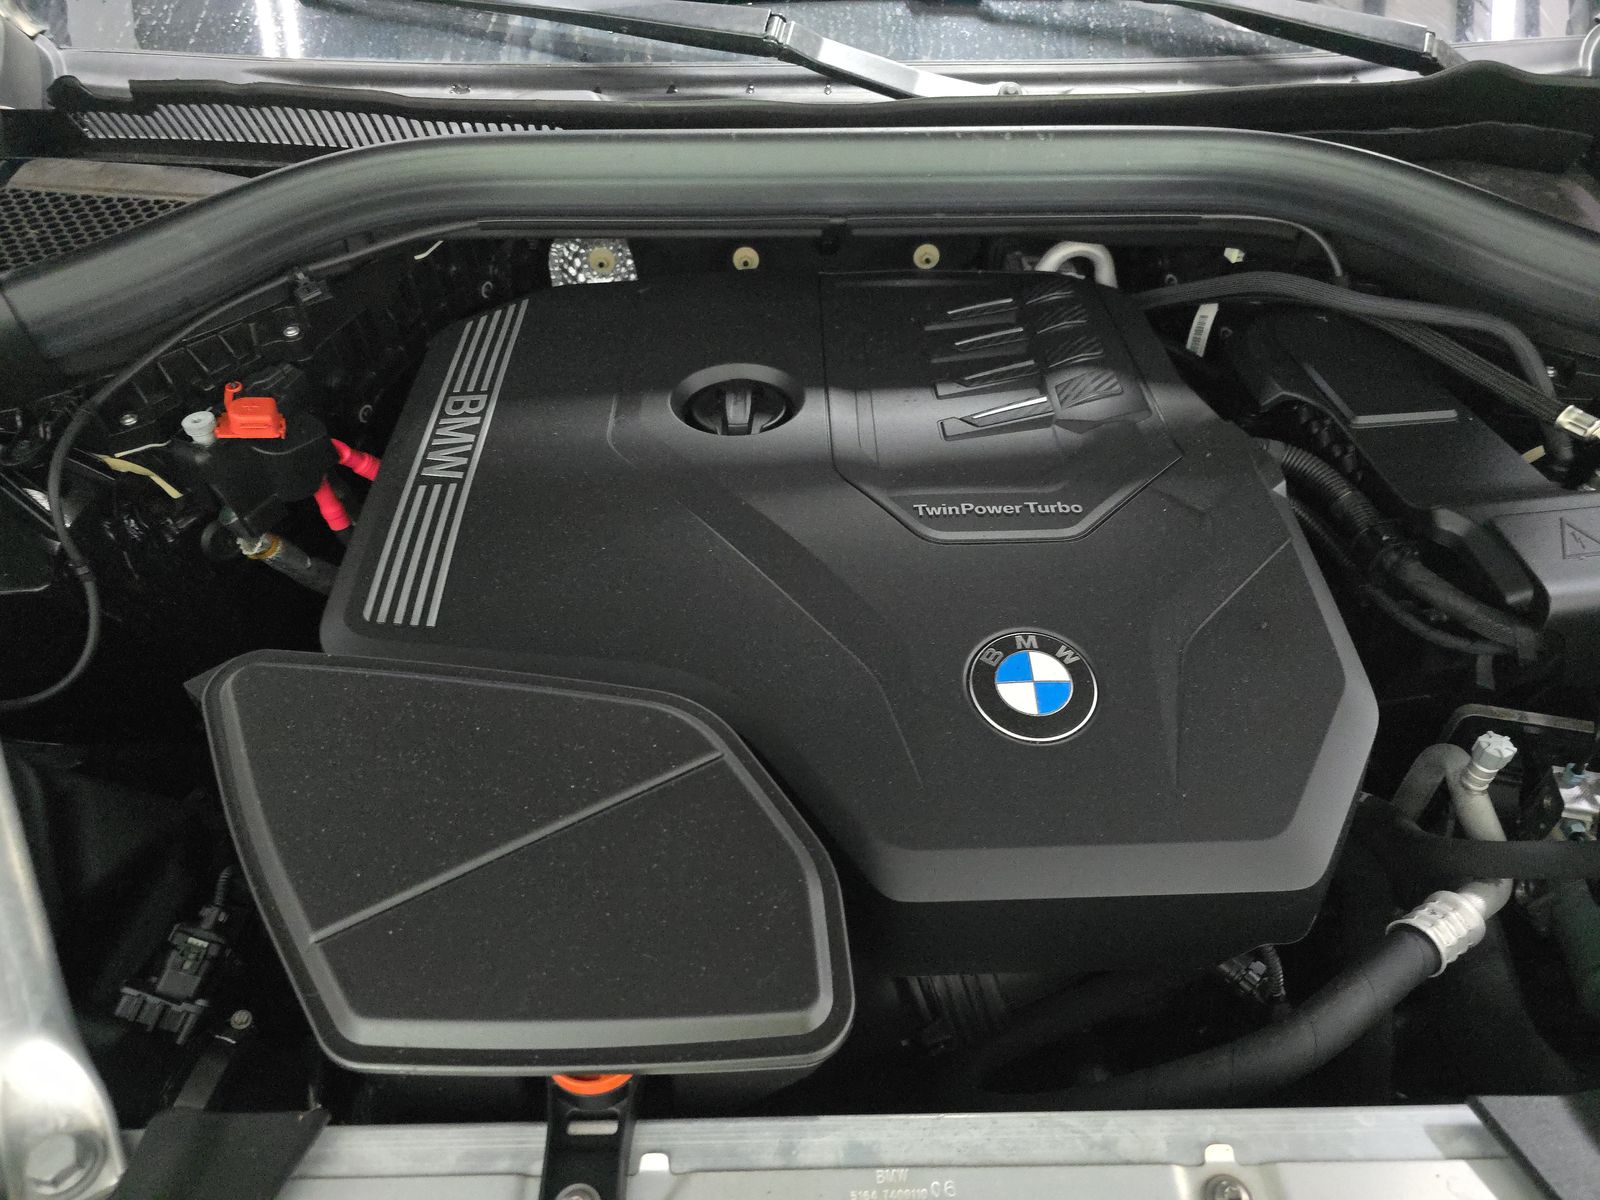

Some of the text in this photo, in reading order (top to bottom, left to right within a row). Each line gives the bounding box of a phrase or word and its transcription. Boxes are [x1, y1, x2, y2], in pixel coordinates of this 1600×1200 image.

[421, 394, 488, 479] BMW
[980, 635, 1080, 667] BMW
[876, 1168, 909, 1184] BMW
